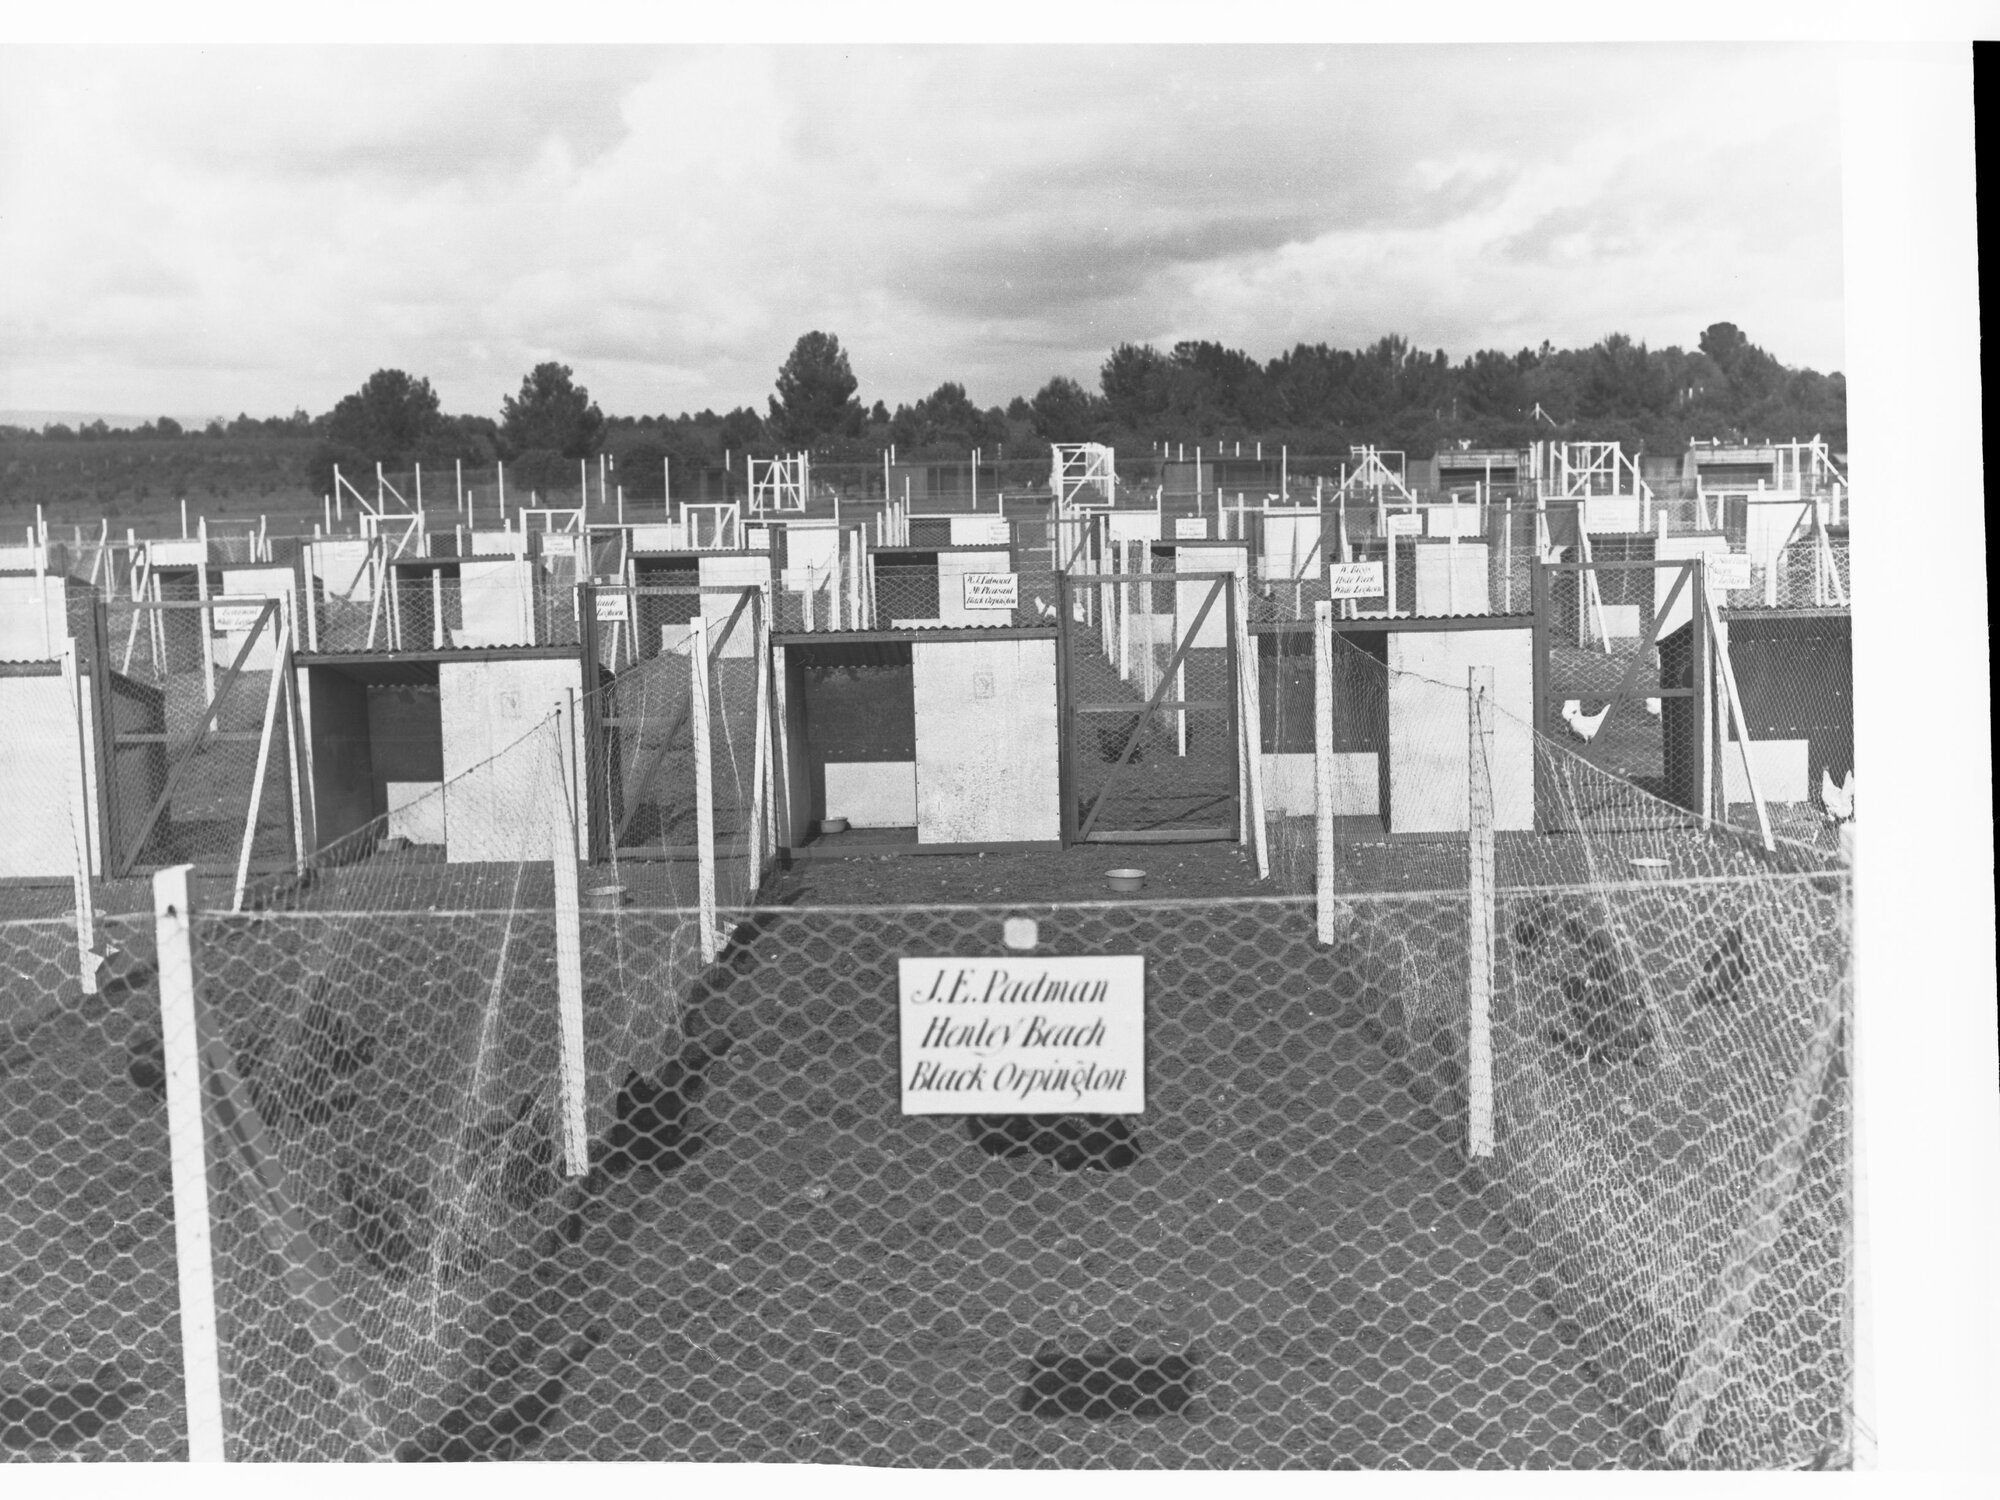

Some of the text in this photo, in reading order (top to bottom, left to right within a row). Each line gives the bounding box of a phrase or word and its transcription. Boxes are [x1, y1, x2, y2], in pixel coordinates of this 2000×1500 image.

[1355, 574, 1375, 584] Park
[981, 586, 1013, 595] Pleasant
[1334, 585, 1382, 595] White Leghorn
[967, 596, 1016, 606] Black Orpington
[920, 1015, 1107, 1057] Henley Beach
[908, 1058, 1128, 1103] Black Orpington
